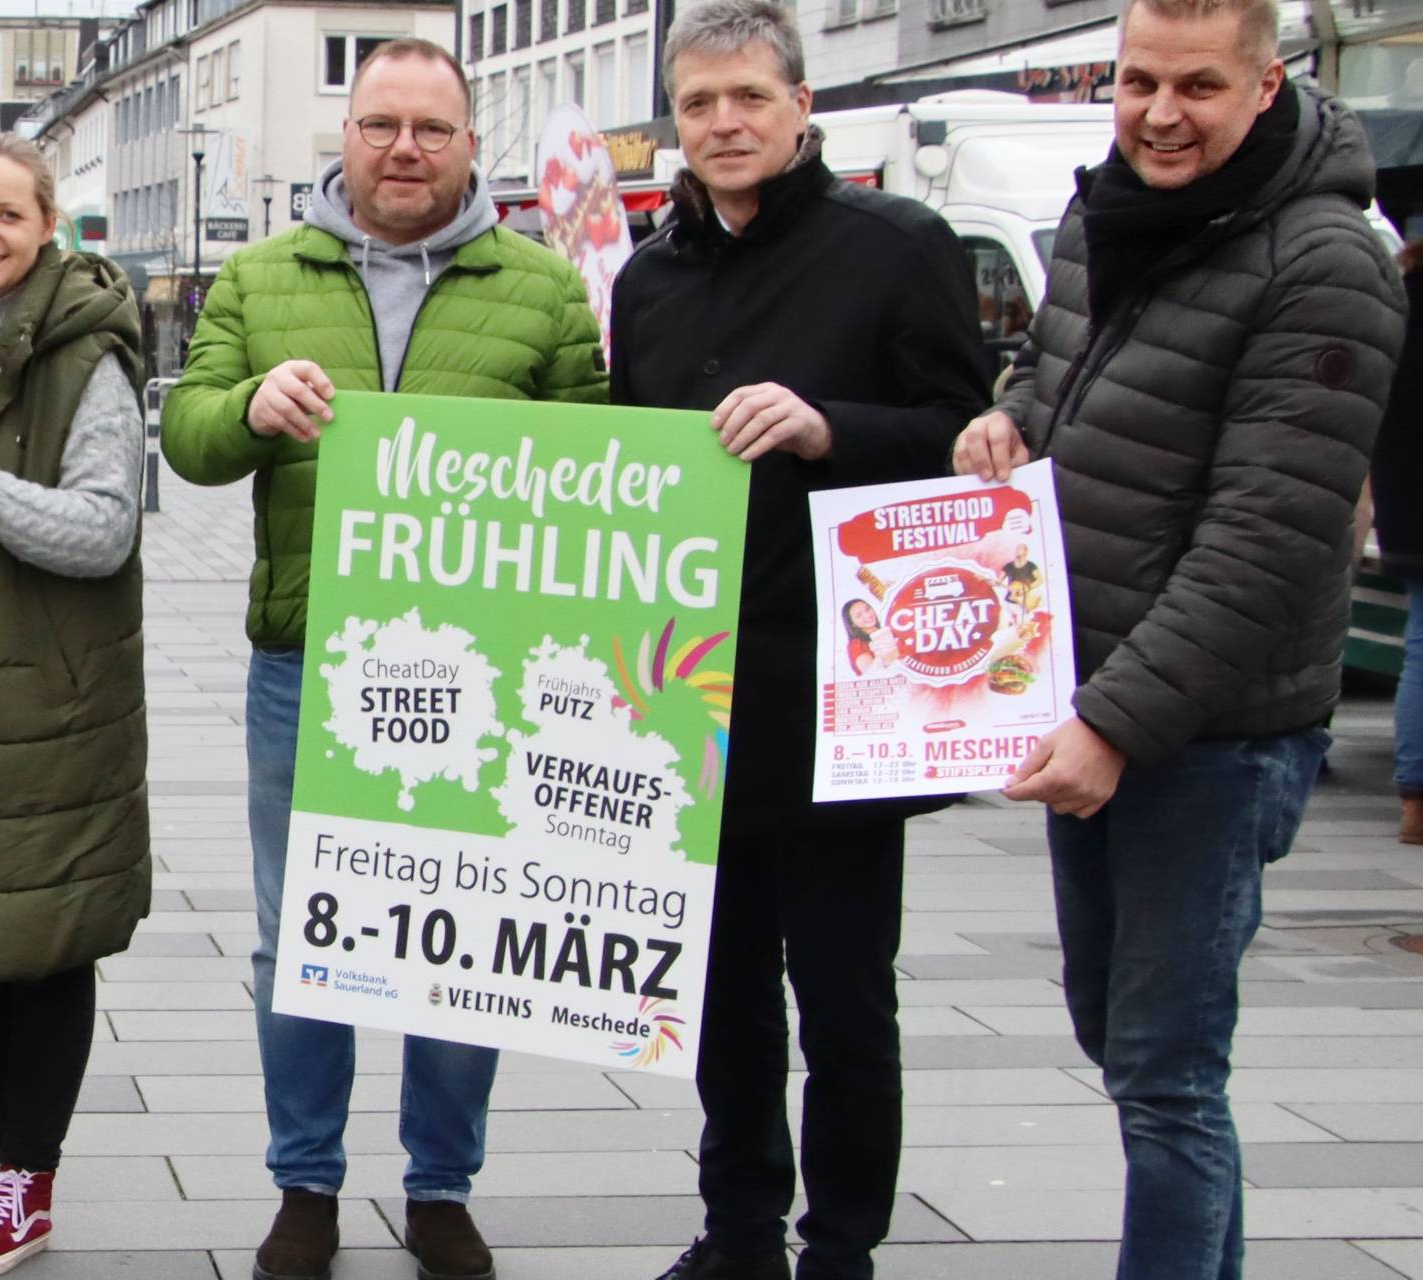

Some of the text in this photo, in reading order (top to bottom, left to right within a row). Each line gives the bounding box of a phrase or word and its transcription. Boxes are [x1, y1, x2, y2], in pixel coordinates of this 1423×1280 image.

[377, 416, 681, 518] Mescheder
[874, 497, 994, 530] STREETFOOD
[892, 522, 979, 551] FESTIVAL
[337, 501, 719, 609] FRÜHLING
[890, 598, 995, 631] CHEAT
[915, 624, 976, 653] DAY
[362, 658, 459, 684] CheatDay
[360, 687, 462, 714] STREET
[538, 674, 602, 699] Frühjahrs
[540, 693, 595, 721] PUTZ
[371, 717, 450, 745] FOOD
[925, 736, 1041, 761] MESCHED
[526, 752, 672, 800] VERKAUFS-
[936, 764, 1010, 778] STIFTSPLATZ
[534, 783, 654, 829] OFFENER
[544, 814, 632, 855] Sonntag
[314, 834, 687, 929] Freitag bis Sonntag
[303, 892, 683, 1000] 8.-10. MÄRZ
[333, 980, 399, 999] Sauerland eG
[335, 968, 388, 986] Volksbank
[448, 987, 533, 1019] VELTINS
[551, 1005, 651, 1038] Meschede
